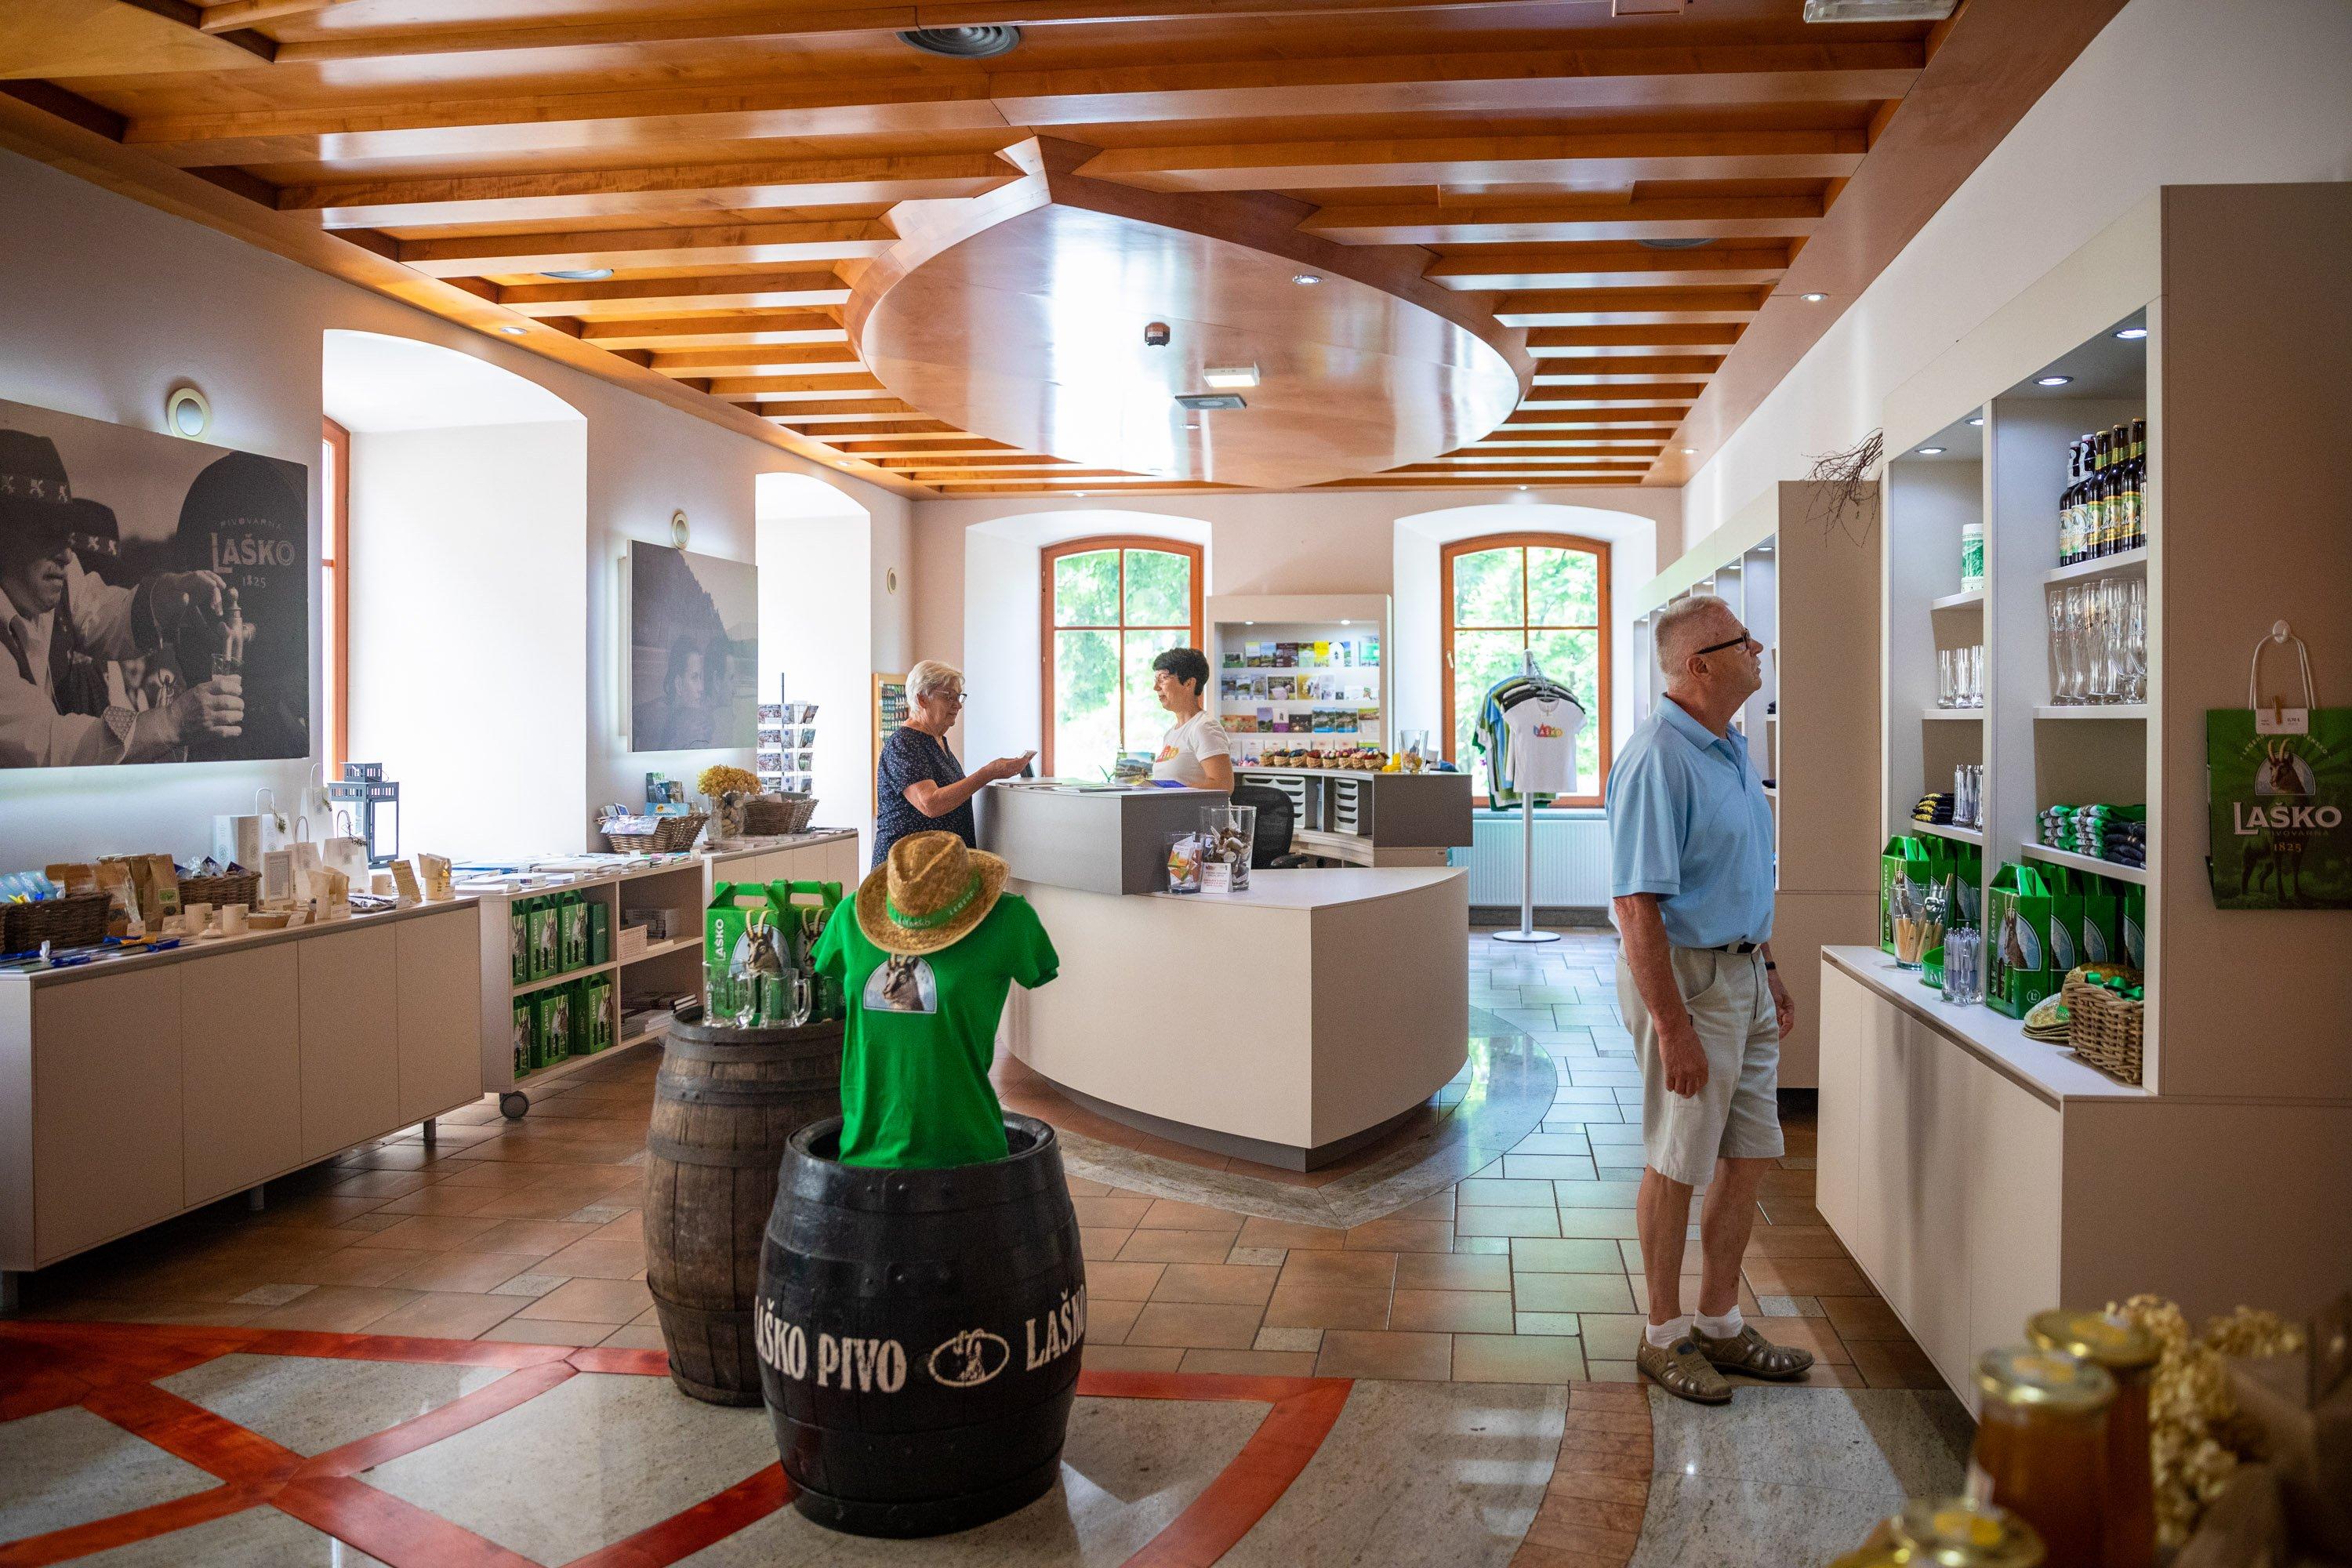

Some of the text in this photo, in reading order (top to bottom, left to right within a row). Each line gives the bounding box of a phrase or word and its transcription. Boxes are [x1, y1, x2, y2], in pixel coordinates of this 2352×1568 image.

[211, 532, 295, 573] LAŠKO
[242, 574, 267, 589] 1825
[2234, 802, 2342, 835] LAŠKO
[2274, 843, 2302, 852] 1825
[816, 1333, 907, 1393] PIVO
